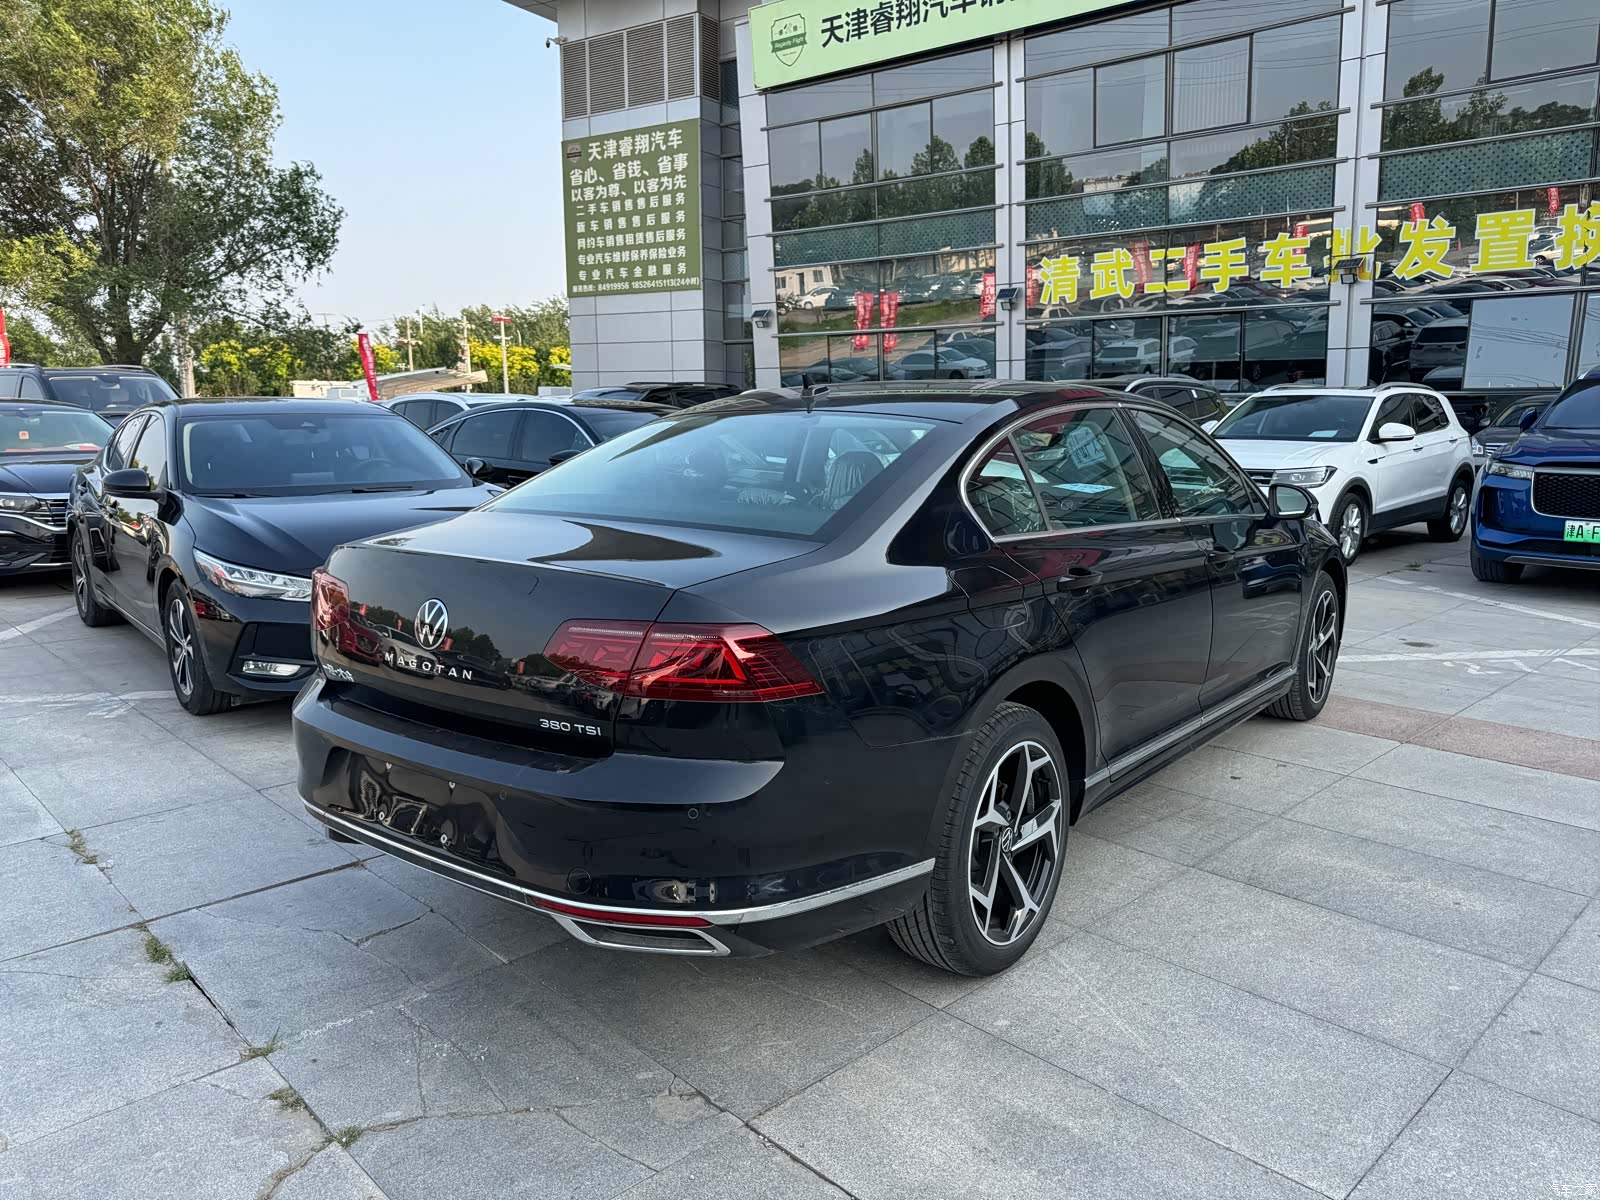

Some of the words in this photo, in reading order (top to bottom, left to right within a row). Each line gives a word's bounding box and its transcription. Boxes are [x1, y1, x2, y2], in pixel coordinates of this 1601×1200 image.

[820, 0, 1001, 48] 天津睿翔汽
[588, 128, 683, 162] 天津睿翔汽车
[569, 153, 689, 187] 省心、省钱、省事
[571, 174, 687, 202] 以客为尊、以客为先
[576, 192, 685, 216] 二手车销售售后服务
[576, 210, 686, 234] 新车销售售后服务
[577, 228, 686, 250] 网约车销售租赁售后服务
[577, 245, 686, 266] 专业汽车维修保养保险业务
[578, 262, 687, 282] 专业汽车金融服务
[597, 281, 630, 292] 84919956
[384, 652, 473, 680] MAGOTAN
[540, 718, 571, 732] 380
[573, 723, 602, 737] TSI
